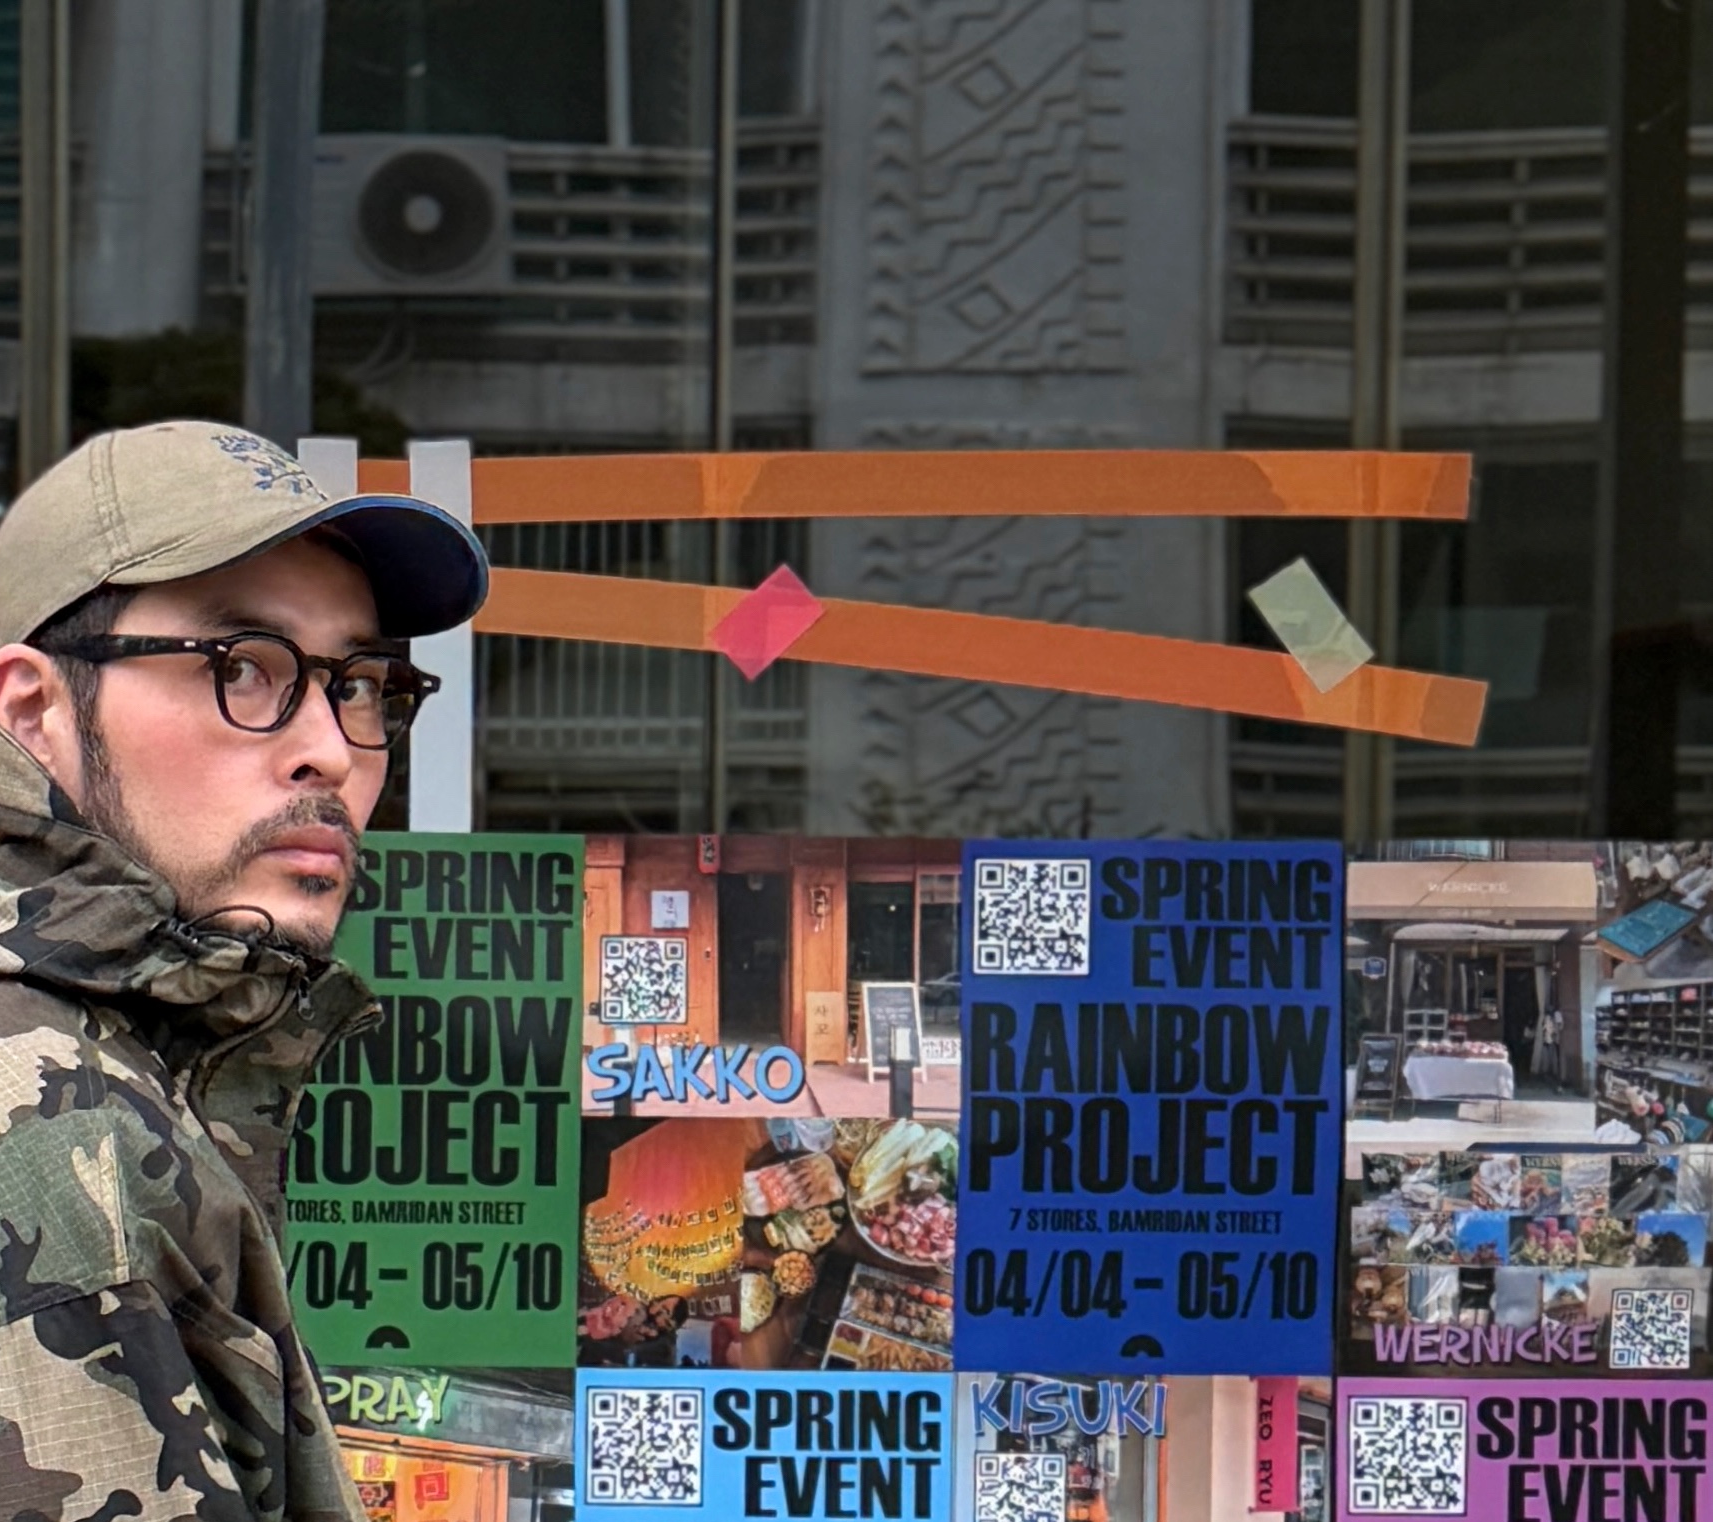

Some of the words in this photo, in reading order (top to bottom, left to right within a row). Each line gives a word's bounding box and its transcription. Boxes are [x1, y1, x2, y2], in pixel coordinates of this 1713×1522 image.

[348, 849, 574, 914] SPRING
[1101, 857, 1332, 922] SPRING
[374, 917, 572, 980] EVENT
[1133, 925, 1330, 989] EVENT
[588, 1042, 805, 1103] SAKKO
[970, 1003, 1329, 1095] RAINBOW
[290, 1089, 570, 1186] ROJECT
[969, 1096, 1329, 1196] PROJECT
[287, 1199, 345, 1223] TORES,
[353, 1201, 453, 1223] BAMRIDAN
[459, 1201, 525, 1224] STREET
[1010, 1208, 1021, 1230] 7
[1028, 1209, 1099, 1232] STORES,
[1109, 1211, 1209, 1232] BAMRIDAN
[1215, 1211, 1280, 1233] STREET
[287, 1241, 372, 1309] /04
[423, 1242, 562, 1310] 05/10
[964, 1249, 1126, 1318] 04/04
[1178, 1251, 1318, 1320] 05/10
[1373, 1323, 1598, 1365] WERNICKE
[321, 1375, 449, 1423] PRAY
[714, 1389, 940, 1451] SPRING
[970, 1379, 1168, 1437] KISUKI
[1259, 1396, 1274, 1441] ZEO
[1477, 1397, 1707, 1460] SPRING
[746, 1457, 938, 1518] EVENT
[1259, 1459, 1274, 1504] RYU
